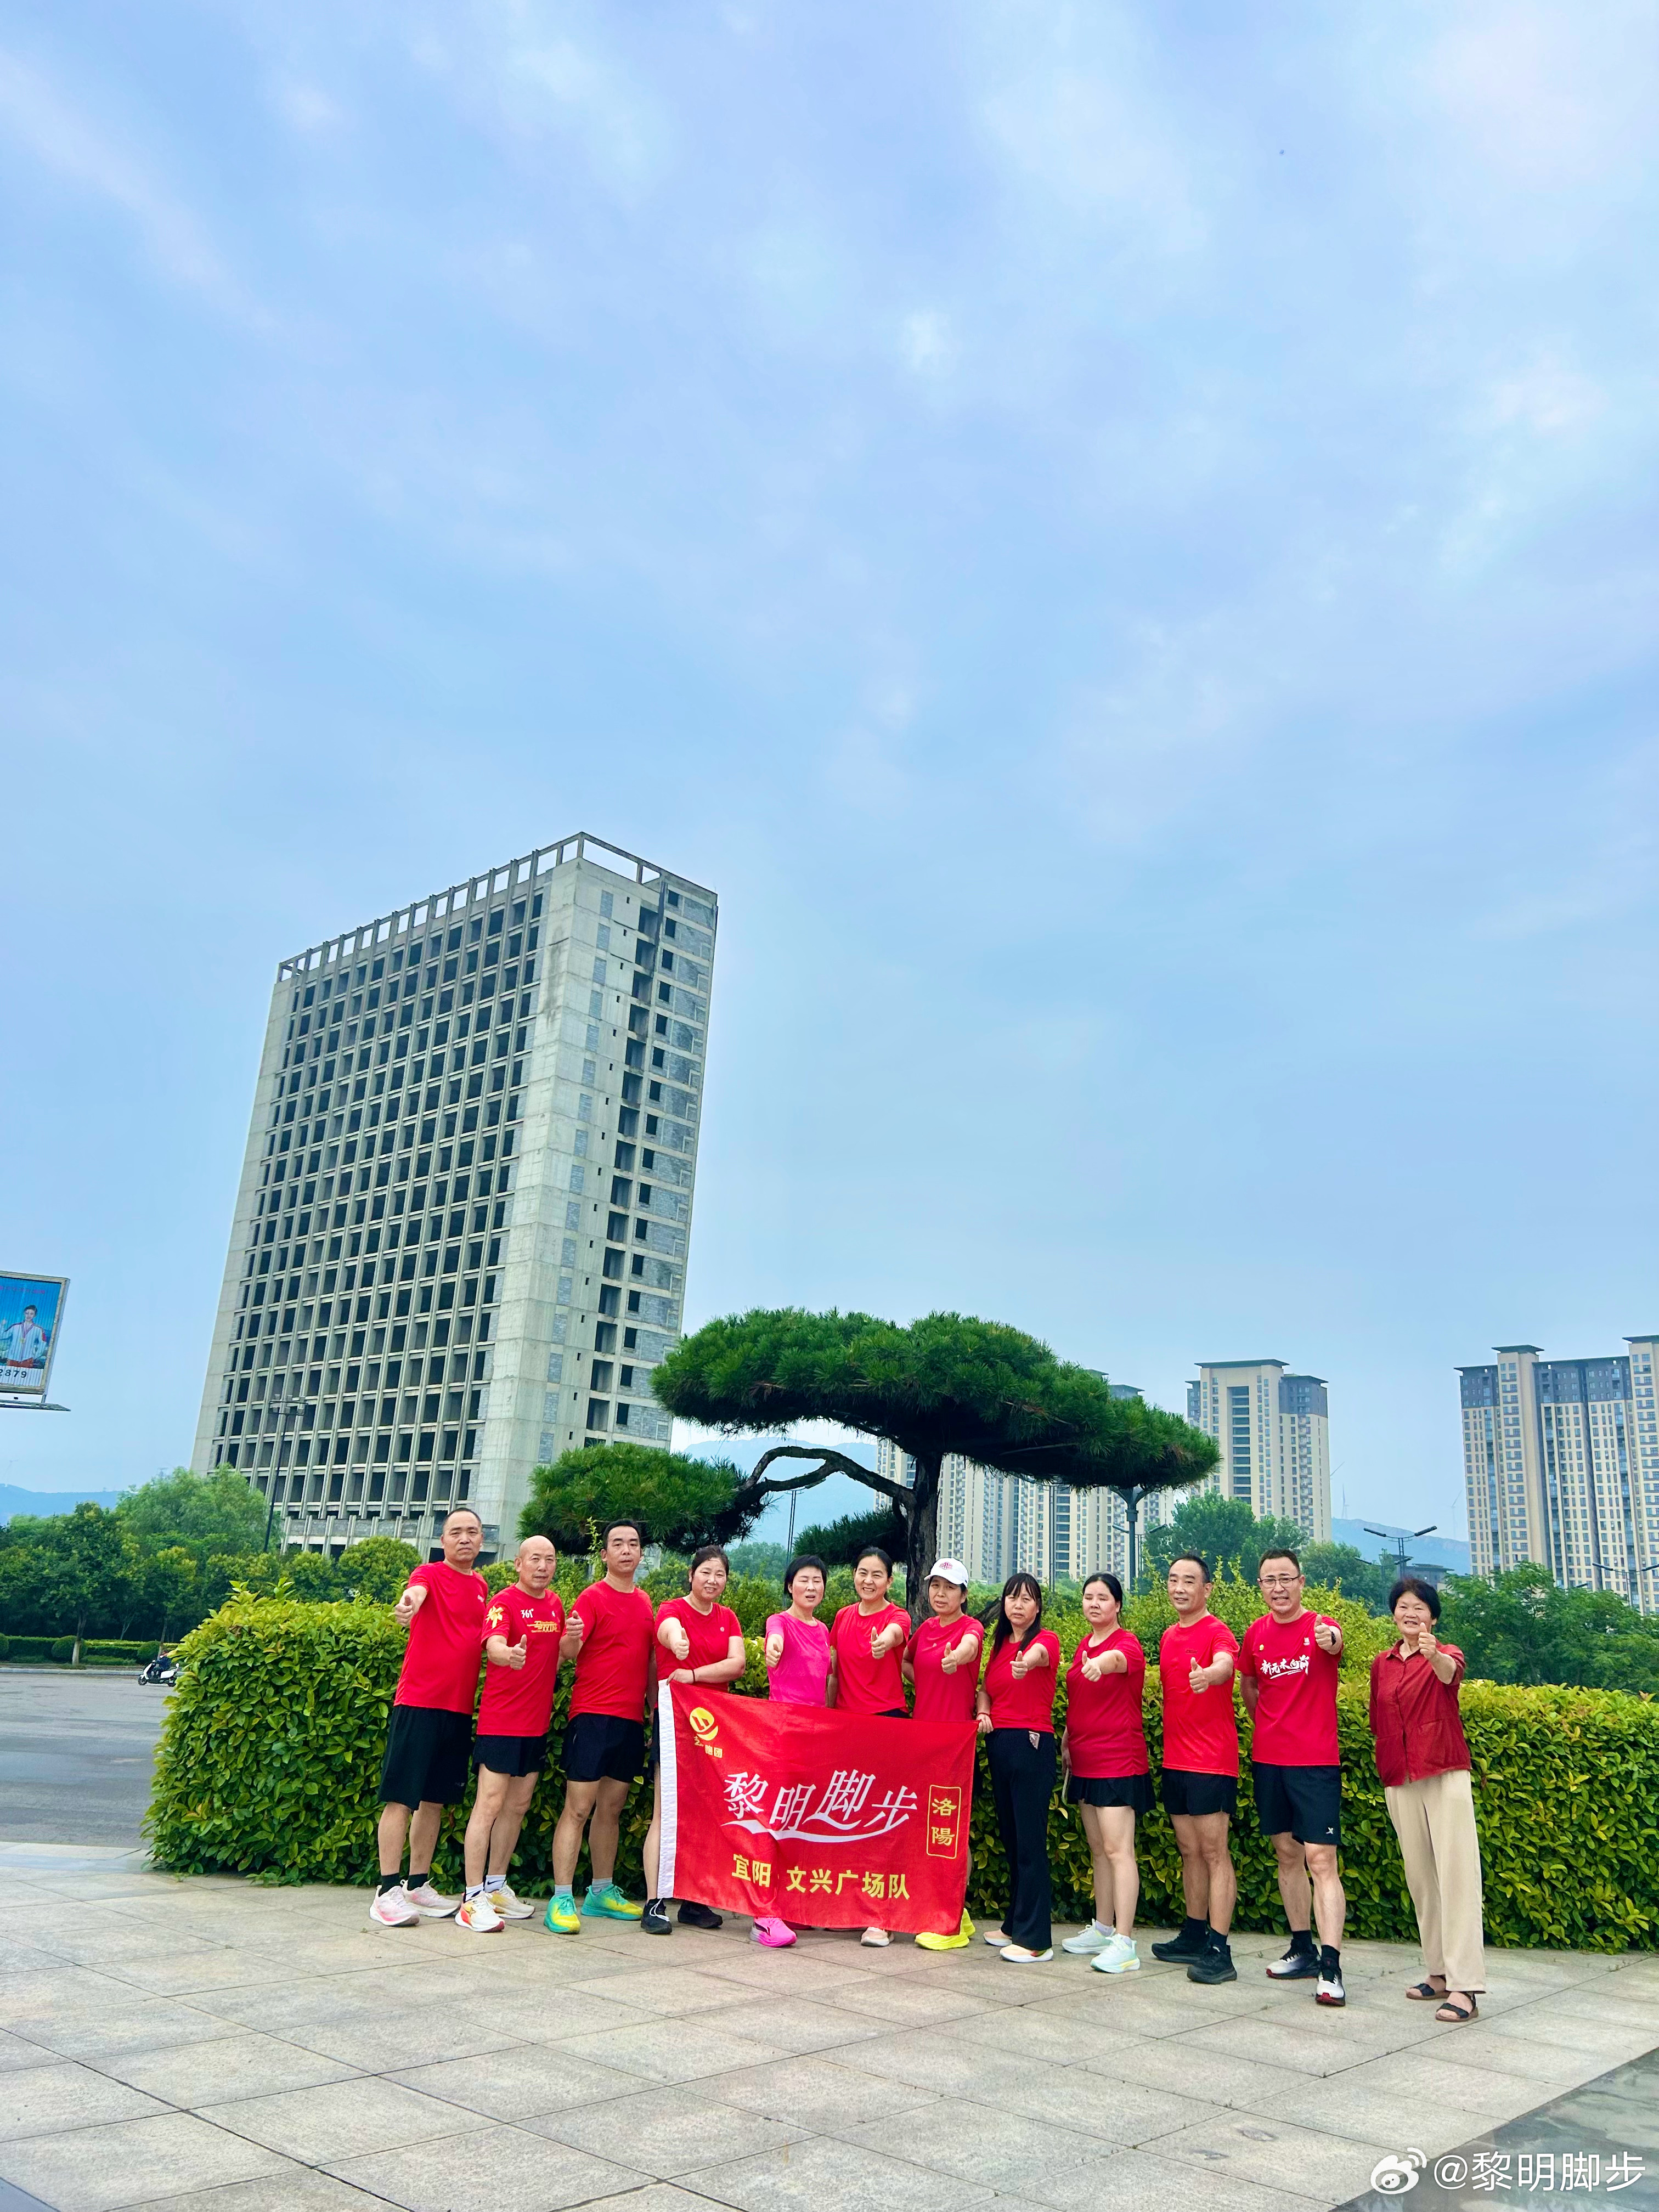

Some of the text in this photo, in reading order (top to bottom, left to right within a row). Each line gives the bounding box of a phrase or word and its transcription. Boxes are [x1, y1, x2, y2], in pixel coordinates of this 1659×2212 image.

[724, 1769, 918, 1831] 黎明脚步
[931, 1797, 957, 1846] 洛陽
[731, 1854, 911, 1900] 宜阳 文兴广场队
